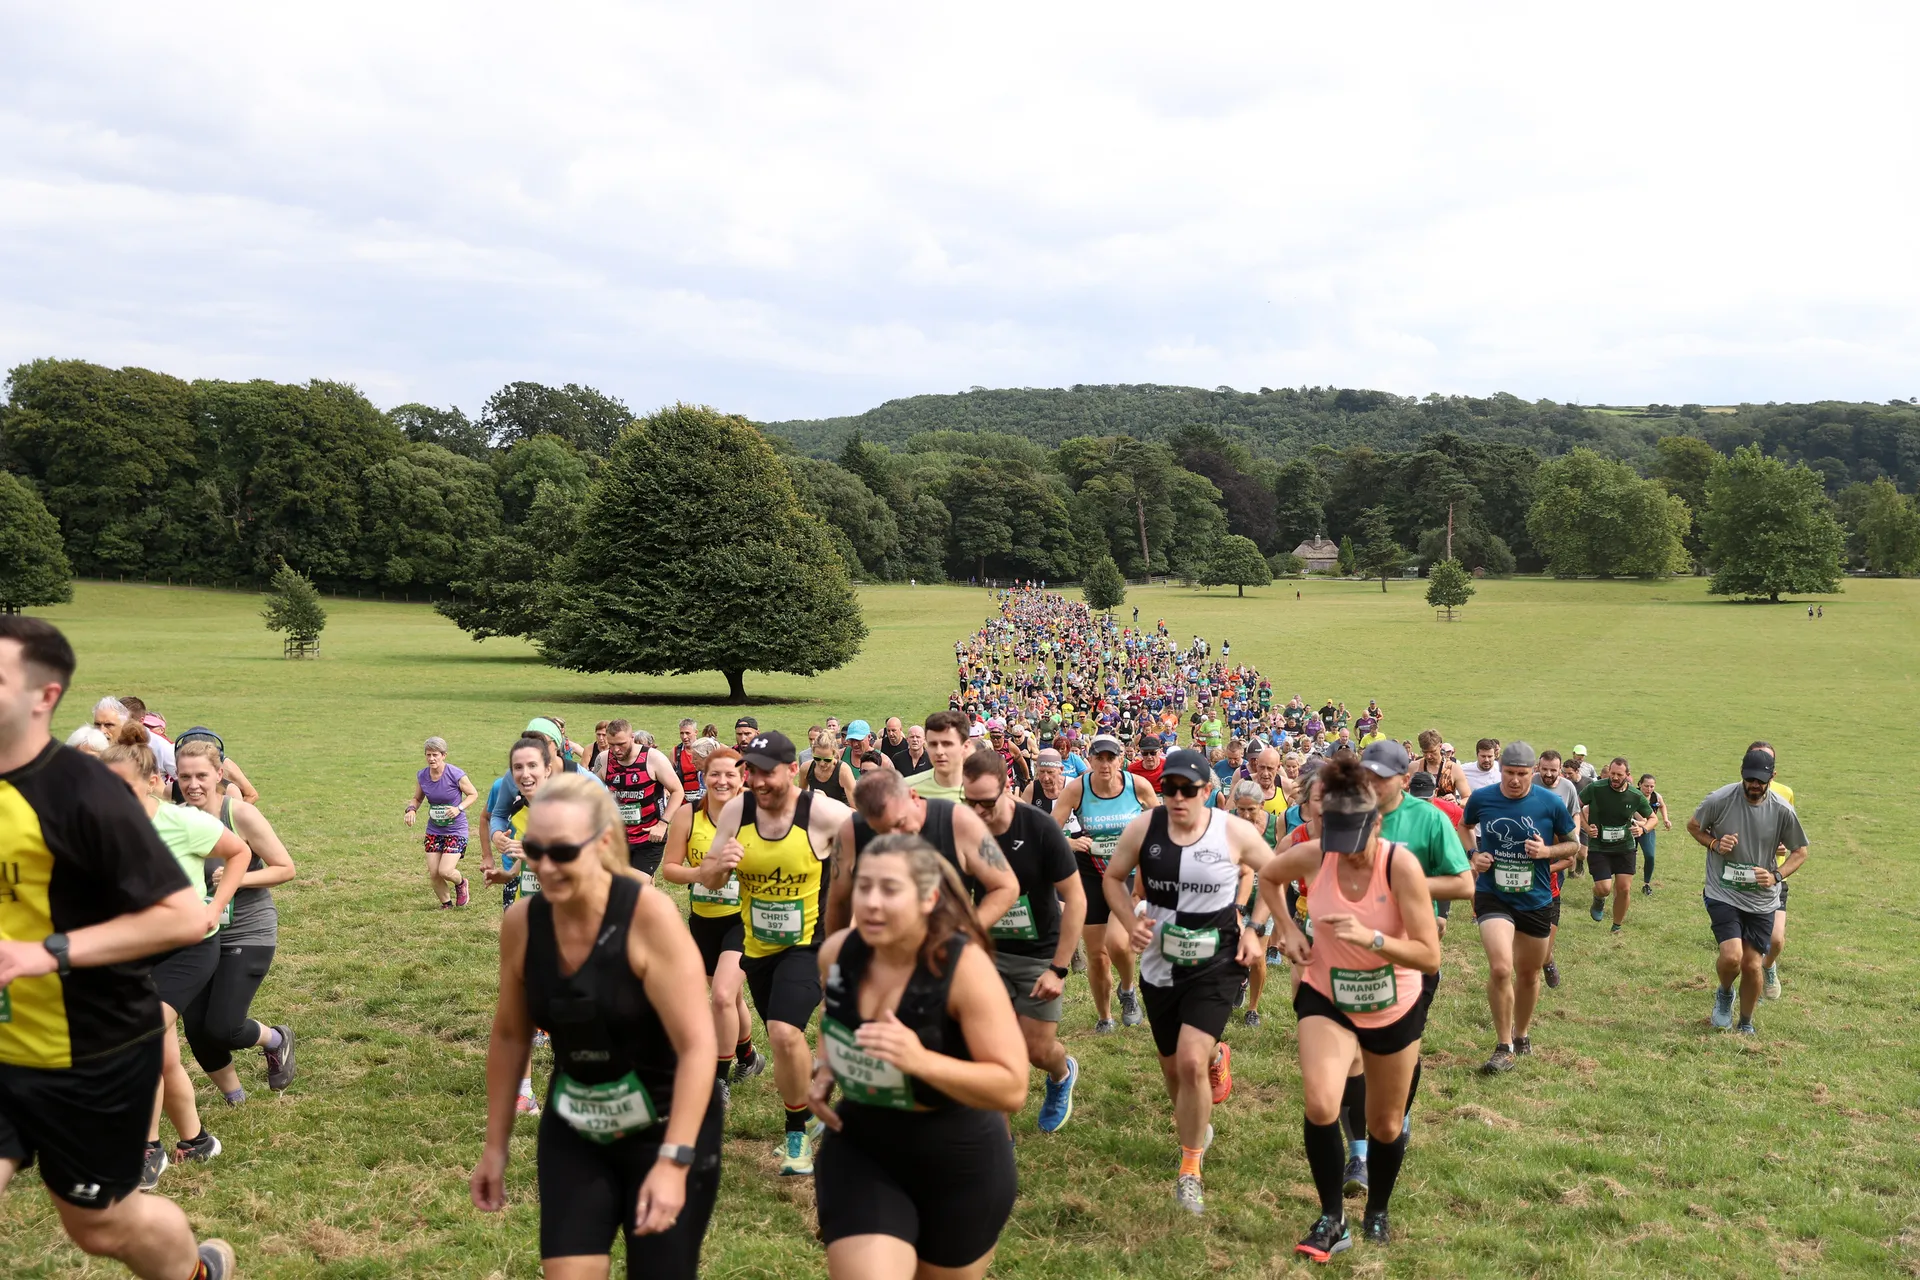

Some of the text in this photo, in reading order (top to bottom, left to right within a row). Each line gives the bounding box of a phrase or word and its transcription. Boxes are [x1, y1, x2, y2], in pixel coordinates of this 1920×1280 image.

[1494, 849, 1516, 858] Rabbit
[743, 881, 799, 896] NEATH
[760, 912, 790, 921] CHRIS
[1006, 909, 1027, 917] AMIN
[767, 921, 783, 929] 397
[1178, 940, 1201, 949] JEFF
[1180, 949, 1197, 957] 265
[1339, 980, 1388, 993] AMANDA
[1354, 993, 1375, 1002] 466
[836, 1044, 886, 1073] LAURA
[568, 1100, 634, 1117] NATALIE
[586, 1118, 620, 1130] 1274
